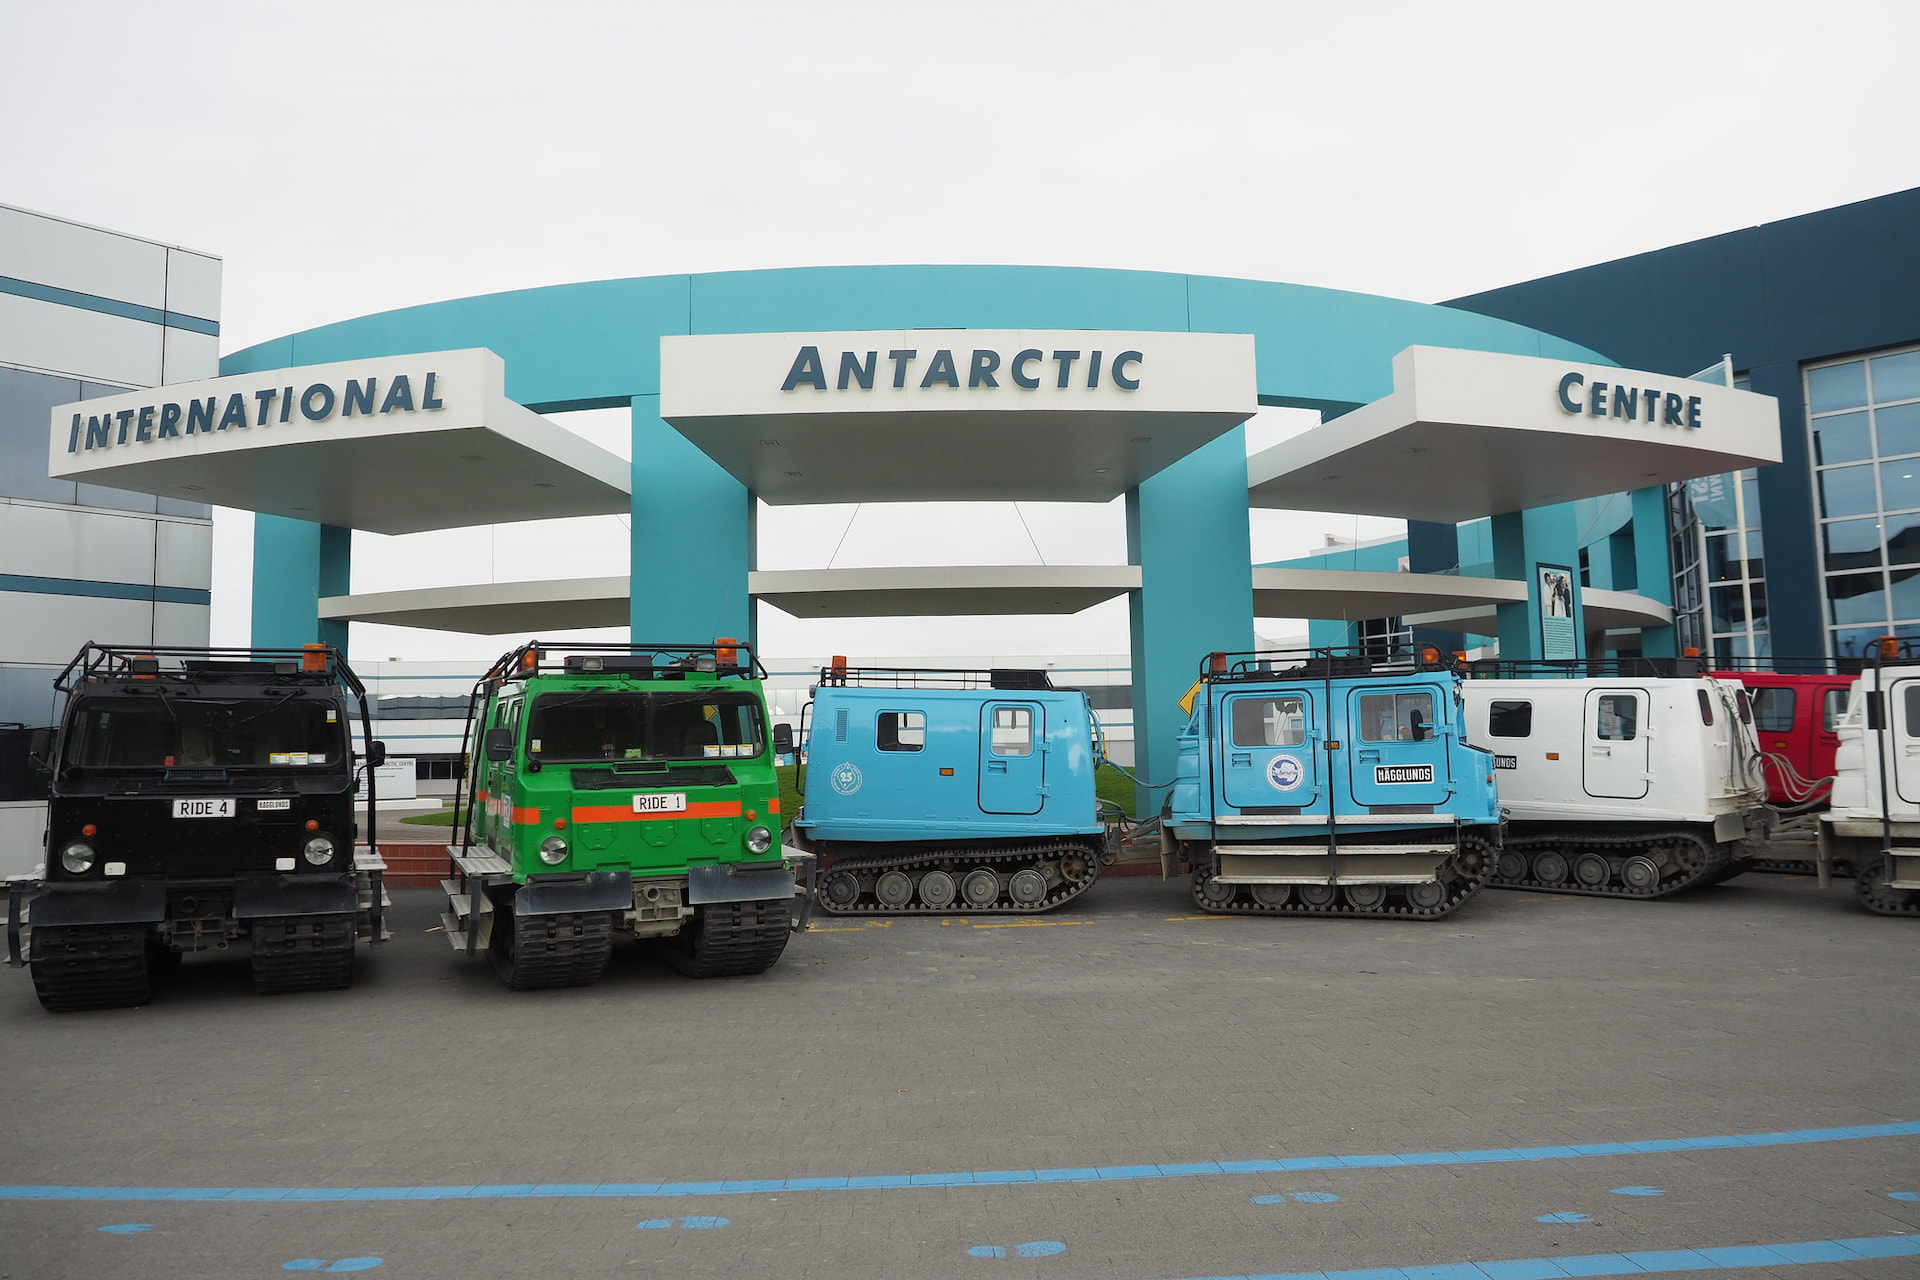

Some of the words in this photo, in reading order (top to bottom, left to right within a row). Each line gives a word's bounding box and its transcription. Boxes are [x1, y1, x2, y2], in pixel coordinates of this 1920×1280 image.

[780, 345, 1144, 391] ANTARCTIC
[1558, 371, 1702, 429] CENTRE
[67, 371, 444, 454] INTERNATIONAL
[840, 771, 853, 782] 25
[1377, 767, 1431, 782] HÄGGLUNDS
[180, 802, 214, 815] RIDE
[219, 801, 228, 815] 4
[676, 796, 680, 808] 1
